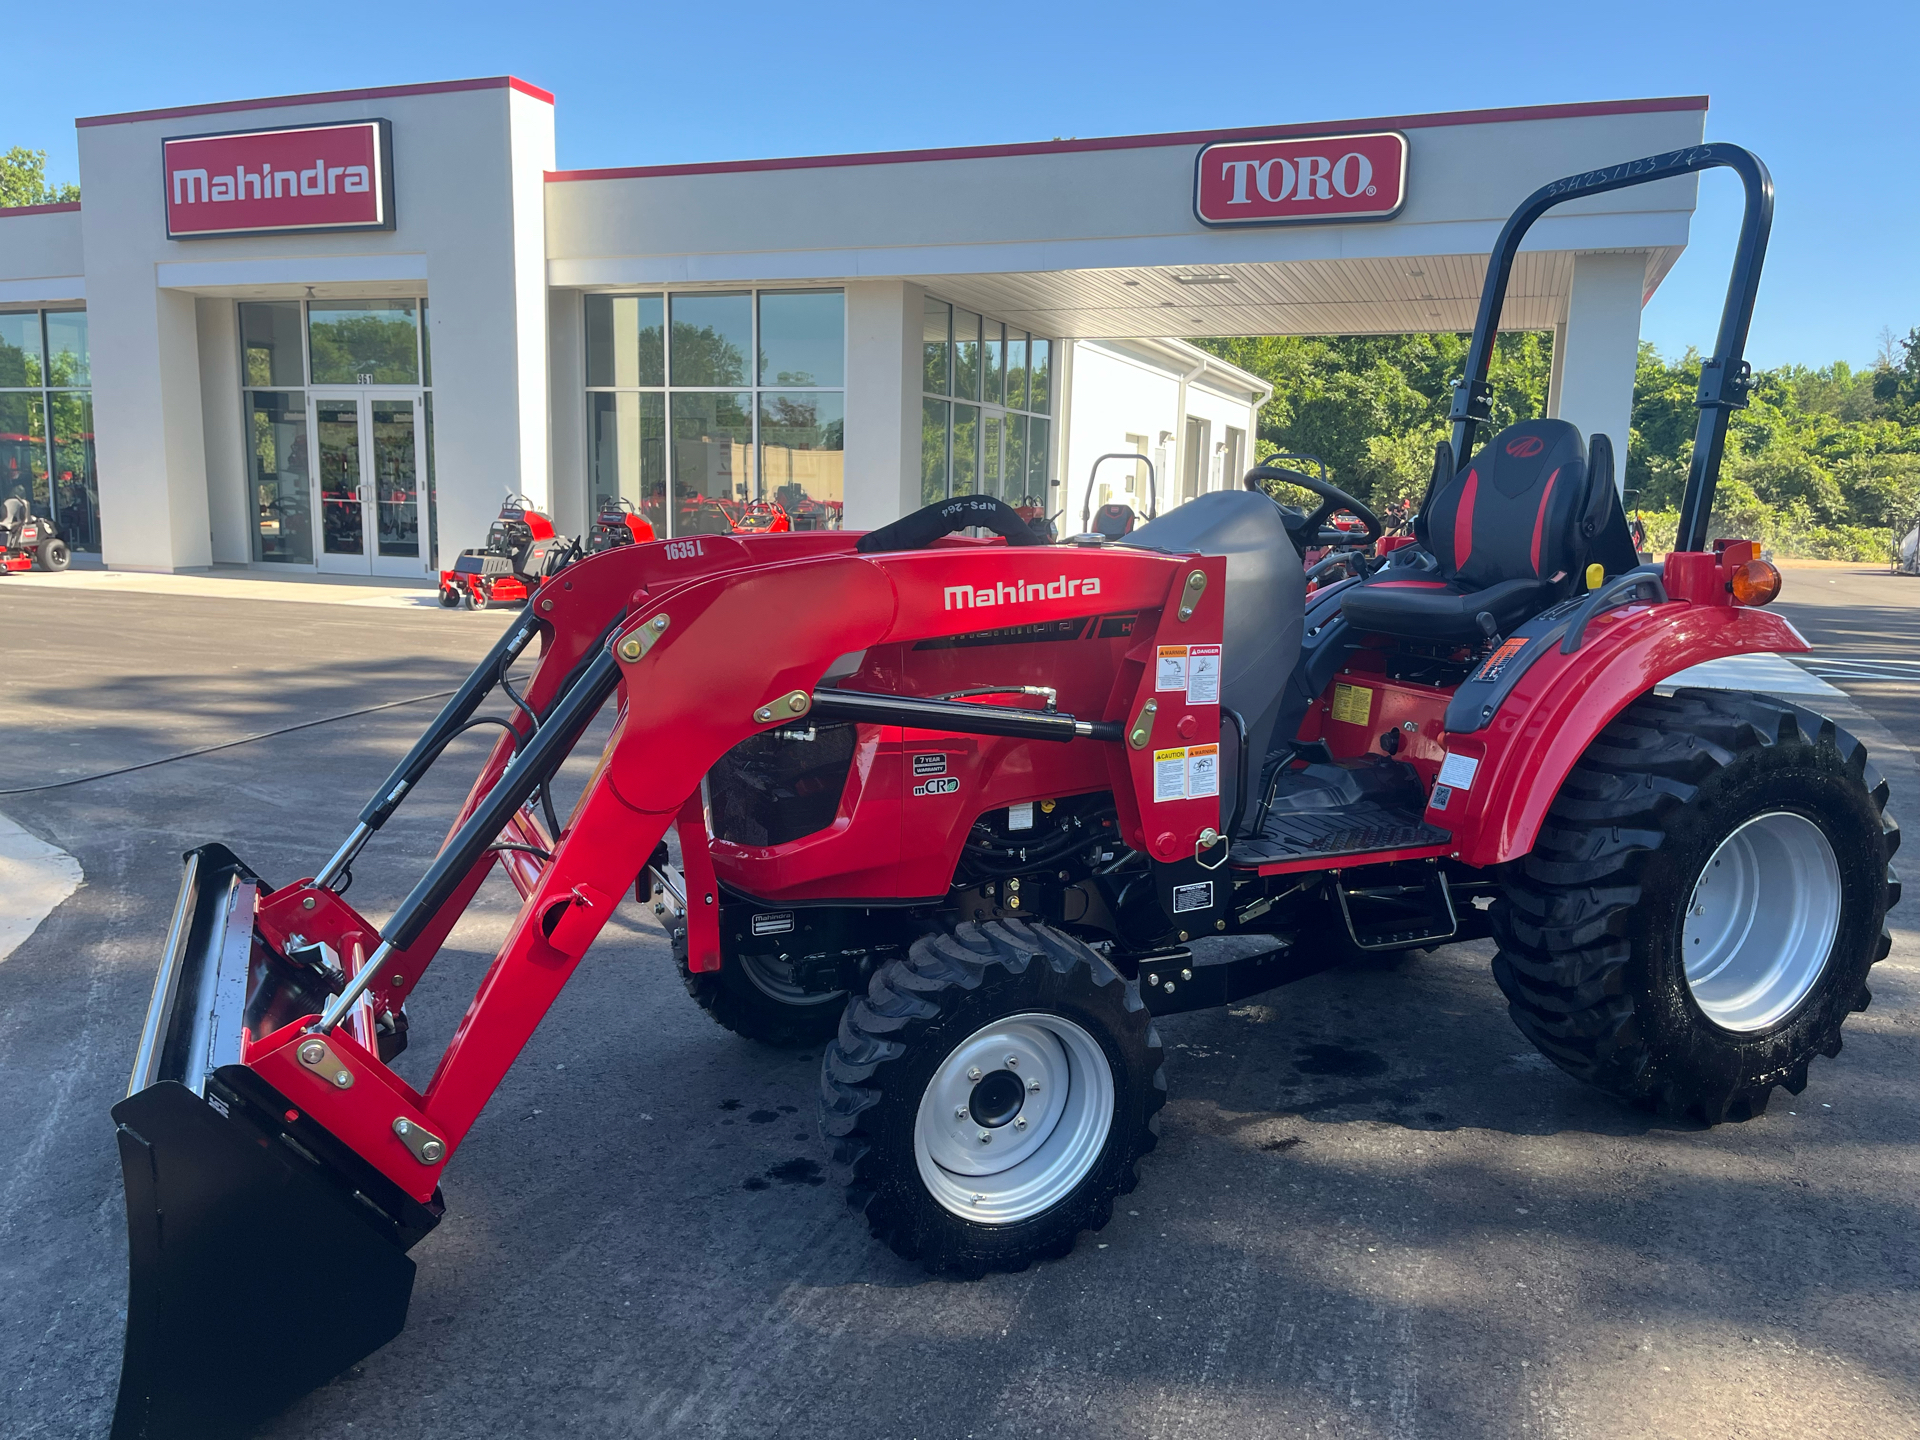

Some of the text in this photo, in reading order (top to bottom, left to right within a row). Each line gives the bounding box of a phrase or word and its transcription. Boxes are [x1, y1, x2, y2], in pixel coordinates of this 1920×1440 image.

[173, 159, 370, 204] Mahindra
[941, 501, 997, 518] NPS-264
[664, 540, 704, 561] 1635 L
[944, 575, 1101, 611] Mahindra
[1161, 751, 1185, 760] CAUTION
[755, 913, 791, 922] Mahindra
